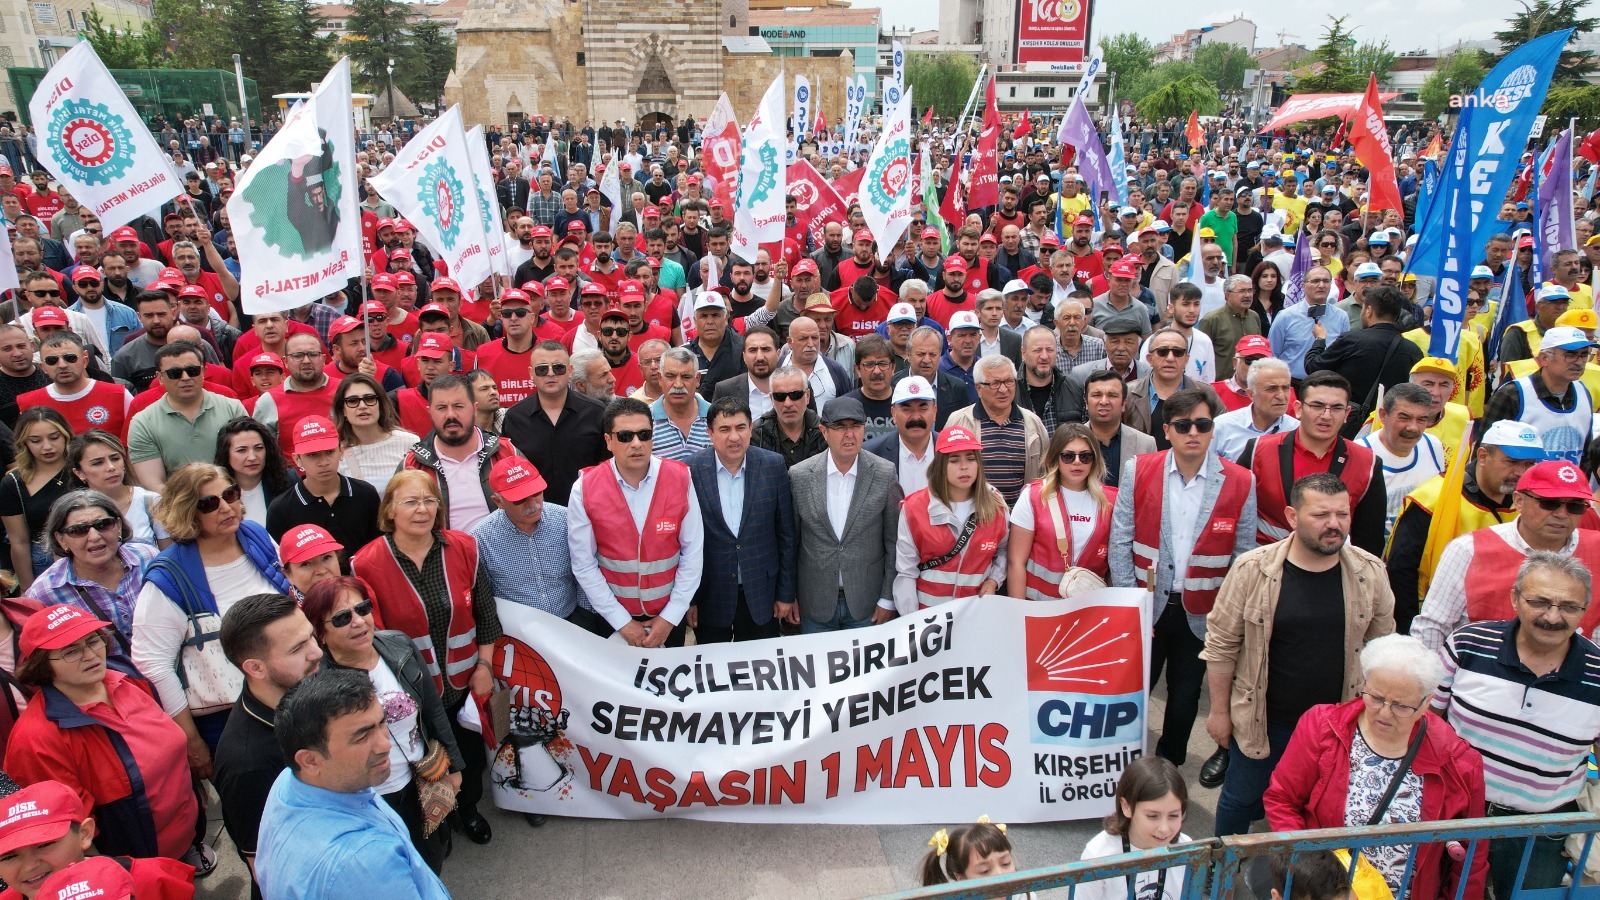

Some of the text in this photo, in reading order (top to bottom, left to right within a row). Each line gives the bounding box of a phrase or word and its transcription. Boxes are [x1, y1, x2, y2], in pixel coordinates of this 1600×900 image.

[761, 30, 806, 38] MODELAND
[852, 319, 880, 331] DİSK
[501, 379, 537, 390] BİRLEŞ
[303, 421, 321, 432] DİSK
[951, 535, 967, 555] GUESS
[46, 606, 72, 621] DİSK
[502, 643, 515, 678] 1
[634, 611, 954, 702] İŞÇİLERİN BİRLİĞİ
[591, 665, 993, 746] SERMAYEYİ YENECEK
[1037, 699, 1139, 739] CHP
[576, 722, 1012, 813] YAŞASIN 1 MAYIS
[1040, 778, 1120, 803] İL ÖRGÜ
[8, 801, 37, 817] DİSK
[58, 880, 90, 900] DİSK
